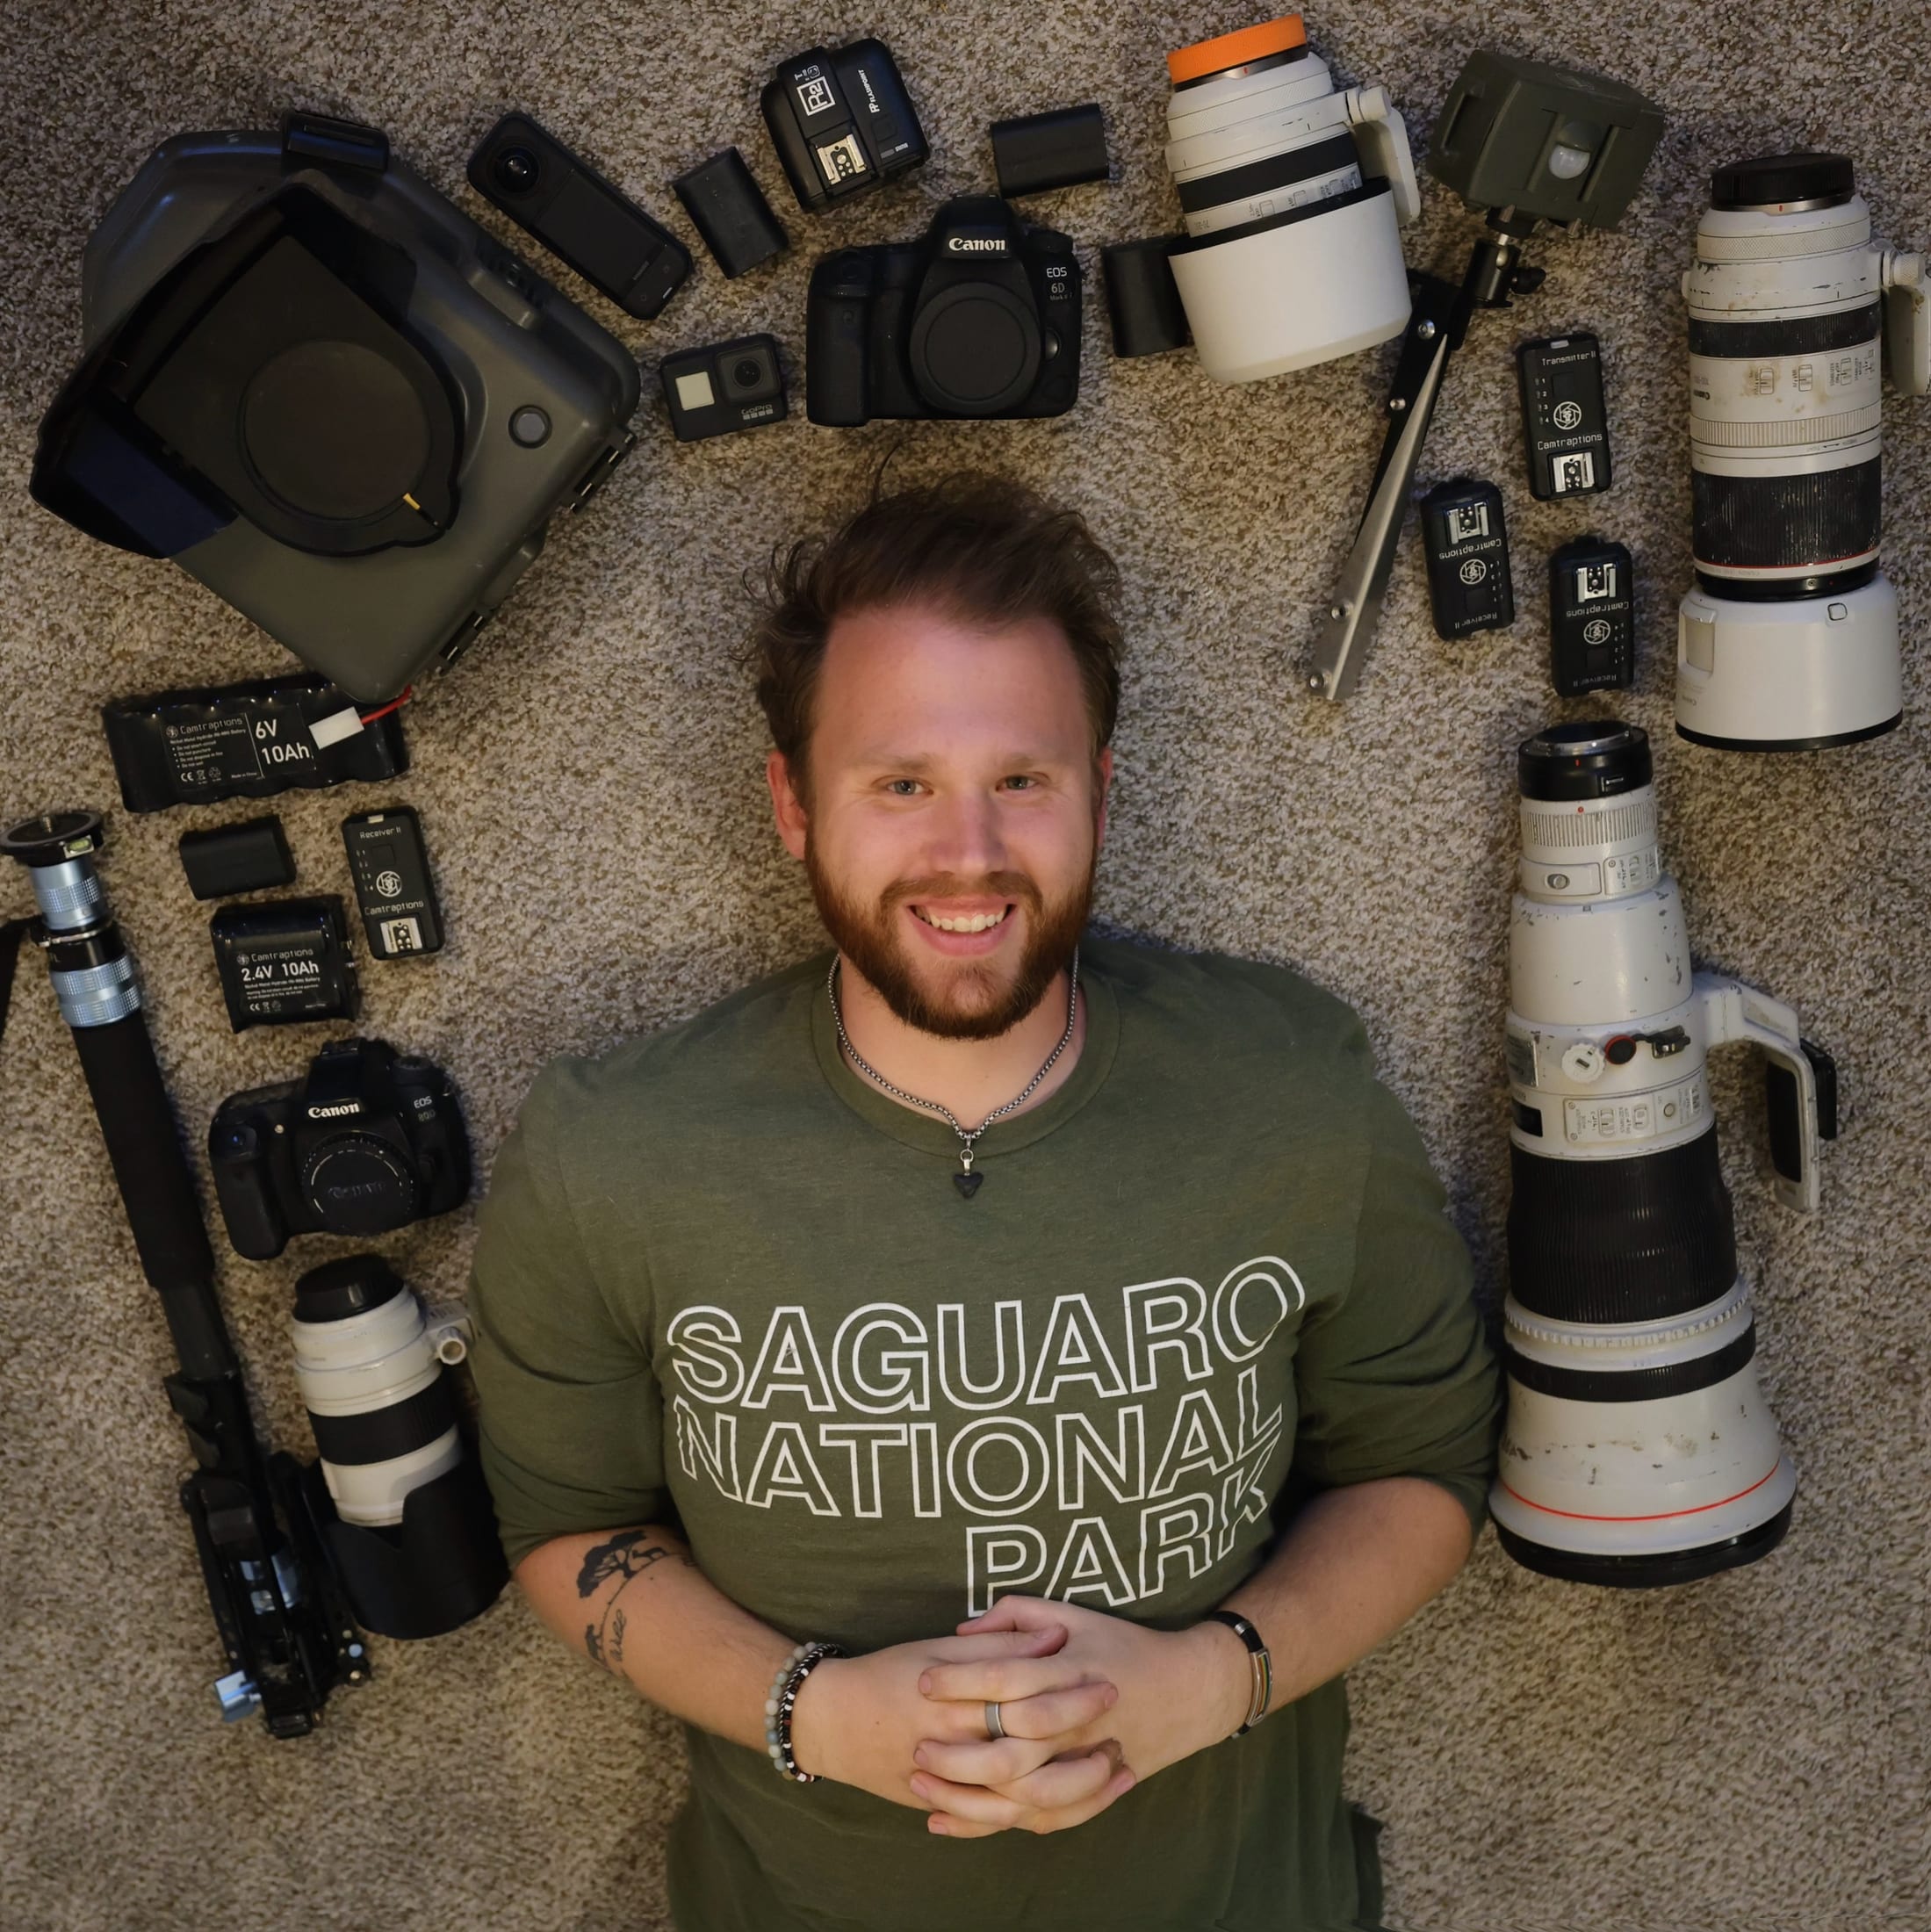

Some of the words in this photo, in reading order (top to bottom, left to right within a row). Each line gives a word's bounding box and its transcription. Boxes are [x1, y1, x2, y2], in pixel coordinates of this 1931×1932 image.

[857, 69, 876, 104] FLASHPOINT
[807, 82, 828, 111] R2
[948, 237, 1005, 251] Canon
[1046, 266, 1068, 278] EOS
[1050, 282, 1065, 293] 6D
[1541, 351, 1590, 366] Transmitter
[741, 404, 773, 415] GoPro
[1537, 433, 1603, 451] Camtraptions
[1439, 538, 1502, 560] Camtraptions
[1566, 601, 1629, 618] Camtraptions
[1461, 612, 1497, 628] Receiver
[1580, 674, 1617, 686] Receiver
[180, 717, 243, 735] Camtraptions
[256, 718, 277, 739] 6V
[262, 742, 310, 765] 10Ah
[359, 828, 394, 839] Receiver
[364, 900, 424, 916] Camtraptions
[251, 948, 314, 962] Camtraptions
[241, 964, 272, 982] 2.4V
[281, 960, 320, 977] 10Ah
[308, 1102, 360, 1119] Canon
[414, 1095, 433, 1109] EOS
[666, 1255, 1306, 1413] SAGUARO
[673, 1366, 1283, 1518] NATIONAL
[966, 1429, 1283, 1618] PARK
